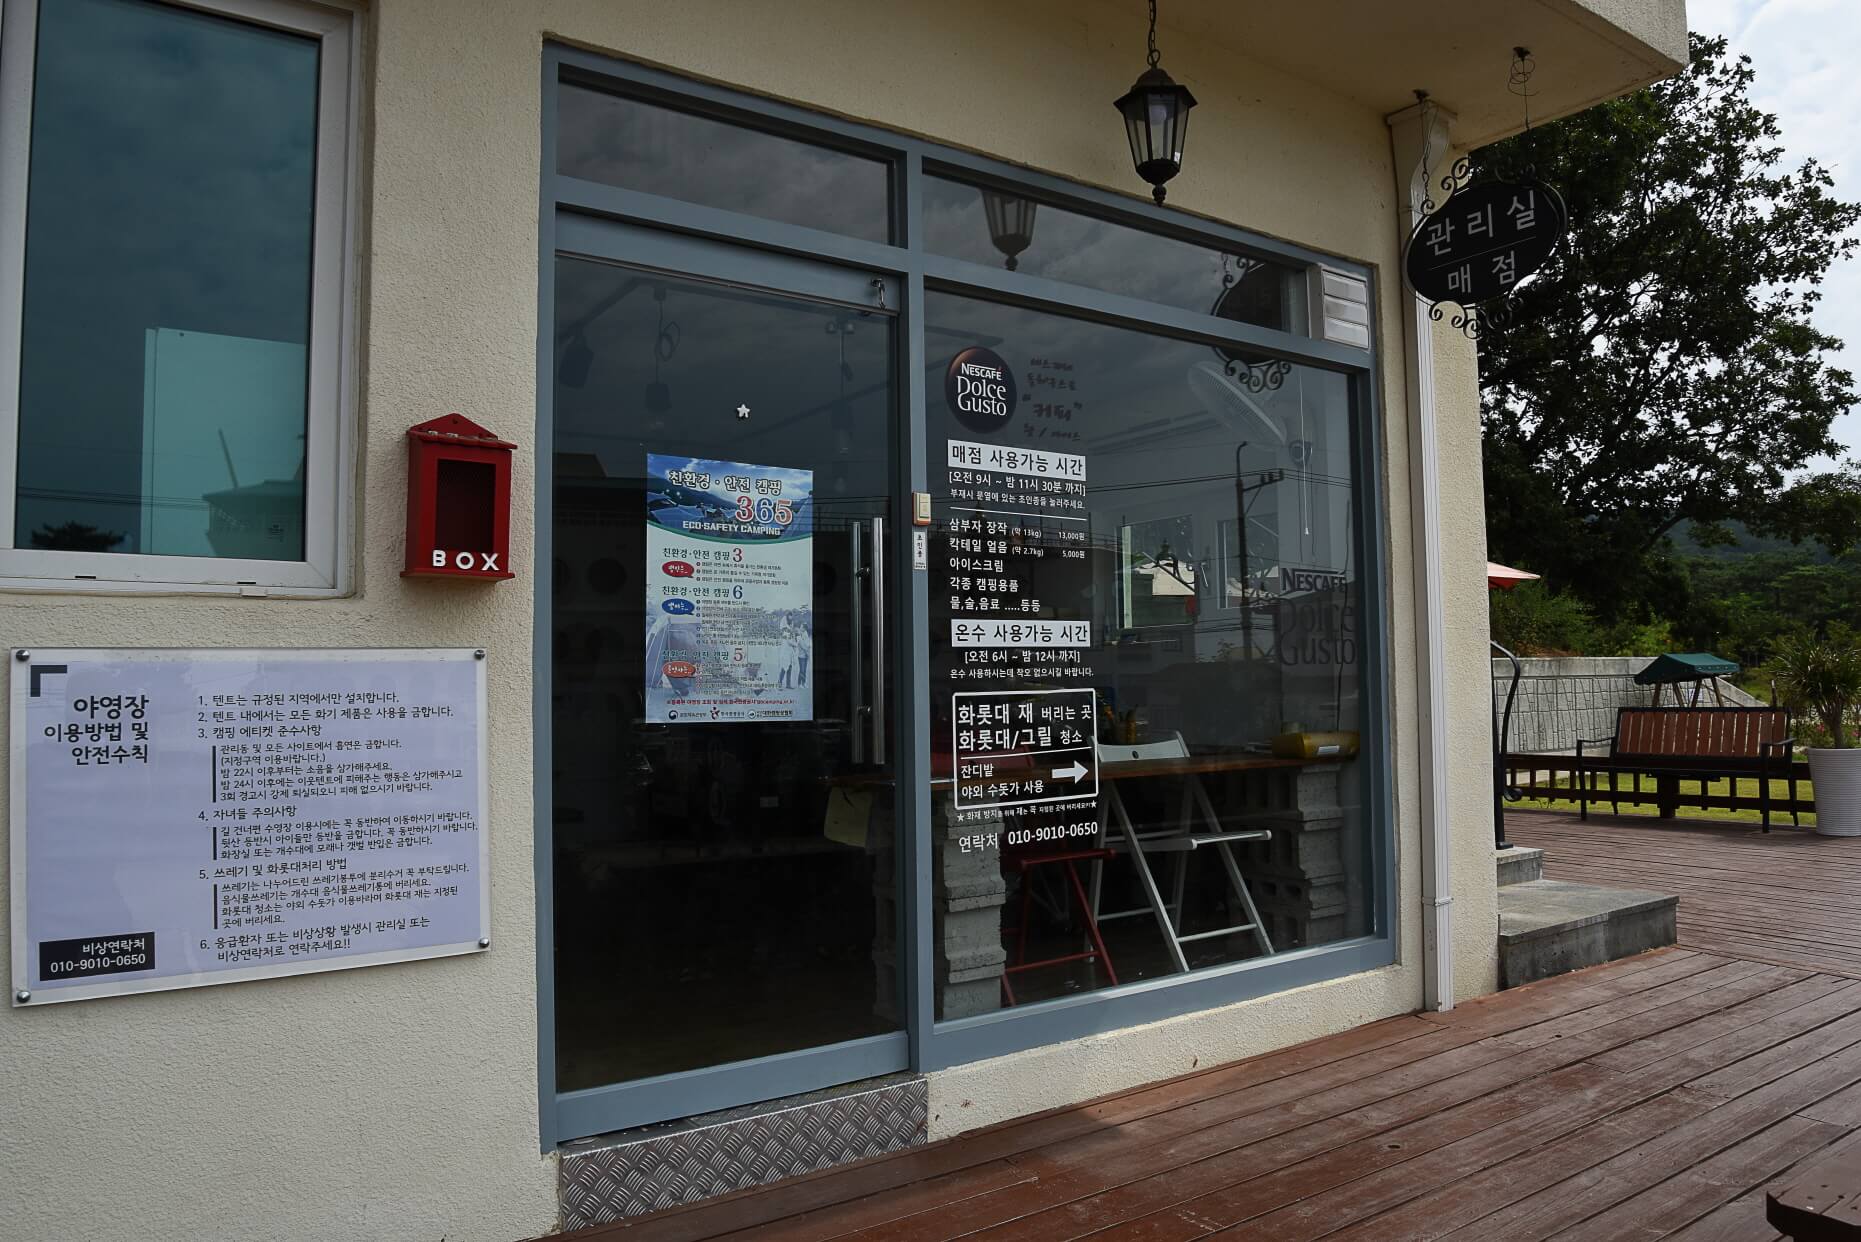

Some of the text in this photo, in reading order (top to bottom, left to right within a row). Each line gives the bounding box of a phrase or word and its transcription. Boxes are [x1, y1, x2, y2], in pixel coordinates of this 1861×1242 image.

[1426, 189, 1536, 256] 관리실
[1448, 250, 1515, 293] 매점
[956, 375, 1007, 401] Dolce
[957, 392, 1007, 416] Gusto
[952, 445, 1083, 476] 매점 사용가능 시간
[669, 470, 781, 496] 친환경 안전 캠핑
[949, 471, 1086, 496] [오전 9시 밤 11시 30분 까지]
[735, 495, 793, 526] 365
[740, 522, 781, 536] CAMPING
[950, 518, 981, 533] 삼부자
[986, 521, 1008, 535] 장작
[732, 547, 743, 562] 3
[950, 538, 981, 552] 칵테일
[987, 540, 1008, 554] 얼음
[433, 550, 499, 571] BOX
[950, 557, 1003, 573] 아이스크림
[732, 585, 743, 599] 6
[950, 577, 1019, 592] 각종 캠핑용품
[955, 624, 1088, 643] 온수 사용가능 시간
[734, 648, 744, 661] 5
[965, 650, 1080, 664] [오전 6시 밤 12시 까지]
[1281, 632, 1355, 666] Gusto
[950, 666, 1094, 679] 온수 사용하시는데 착오 없으시길 바랍니다.
[74, 695, 149, 720] 야영장
[198, 691, 400, 706] 1. 텐트는 규정된 지역에서만 설치합니다.
[198, 705, 454, 722] 2. 텐트 내에서는 모든 화기 제품은 사용을 금합니다.
[958, 702, 1092, 726] 화롯대 재 버리는 곳
[44, 721, 149, 743] 이용방법 및
[198, 724, 322, 739] 3. 캠핑 에티켓 준수사항
[958, 726, 1083, 751] 화롯대/그릴 청소
[72, 744, 149, 766] 안전수칙
[961, 763, 994, 779] 잔디밭
[962, 779, 1044, 800] 야외 수돗가 사용
[198, 805, 297, 822] 4. 자녀들 주의사항
[959, 821, 1098, 853] 연락처 010-9010-0650
[199, 858, 347, 880] 5. 쓰레기 및 화롯대처리 방법
[223, 914, 285, 929] 곳에 버리세요.
[200, 917, 430, 950] 6. 응급환자 또는 비상상황 발생시 관리실 또는
[83, 938, 145, 955] 비상연락처
[218, 938, 351, 963] 비상연락처로 연락주세요!!
[50, 954, 146, 973] 010-9010-0650
